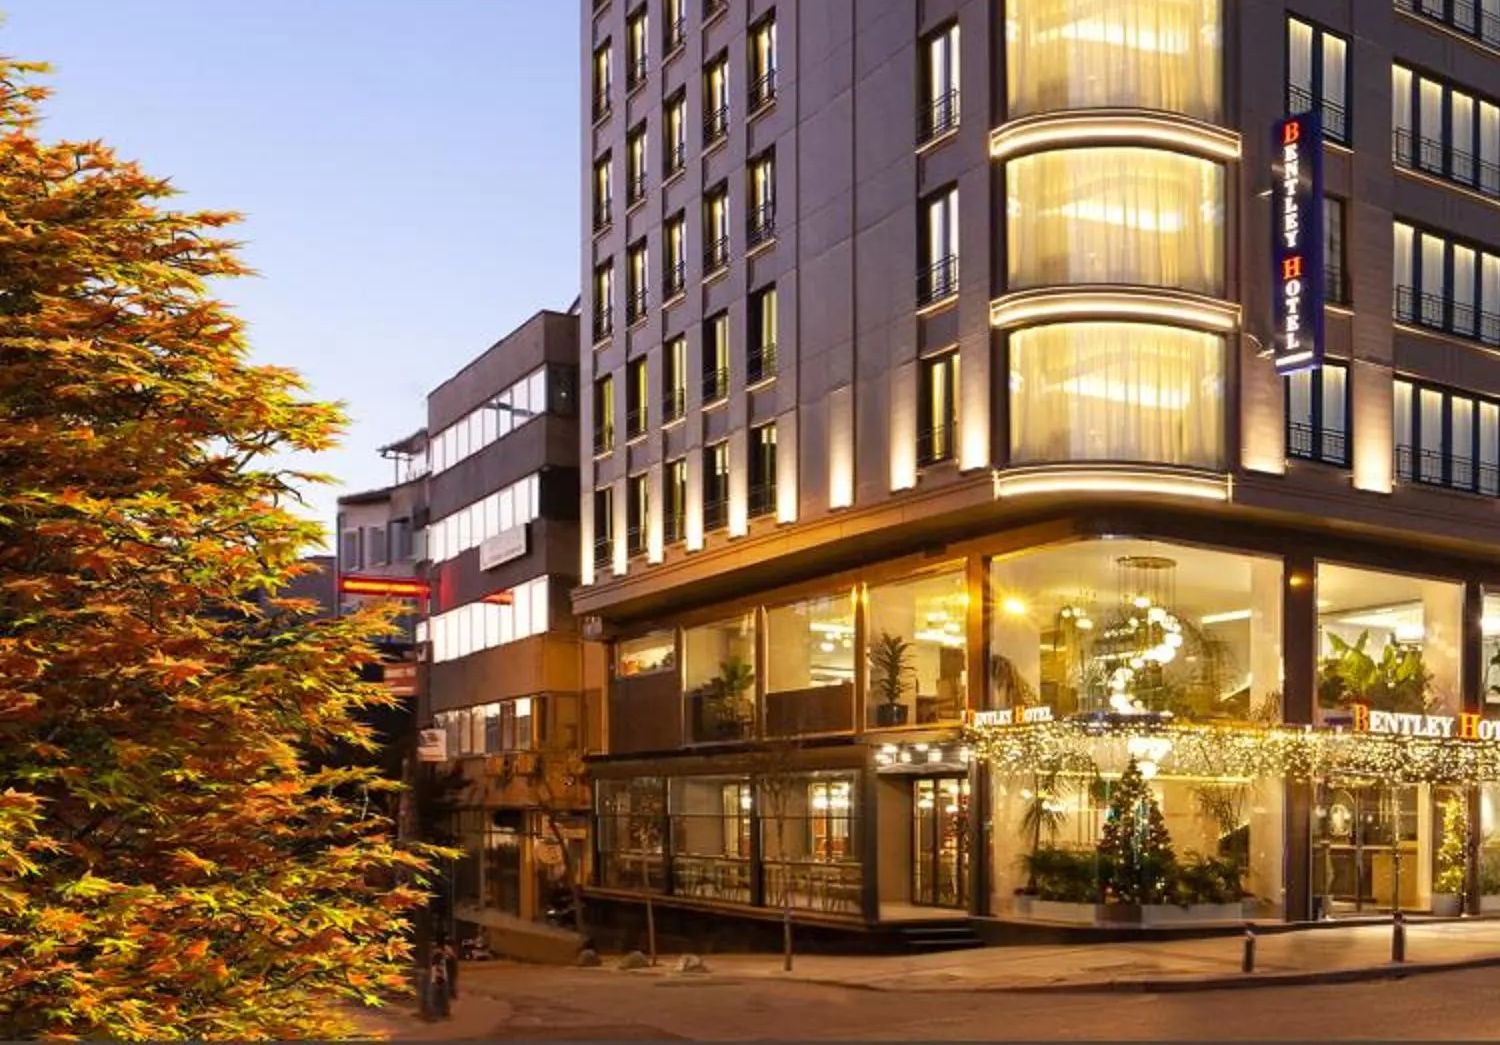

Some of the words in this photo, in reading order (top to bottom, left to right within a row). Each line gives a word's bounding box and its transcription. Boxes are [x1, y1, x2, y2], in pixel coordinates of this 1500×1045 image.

[1283, 121, 1300, 248] BENTLEY
[1283, 256, 1302, 350] HOTEL
[1353, 704, 1455, 738] BENTLEY
